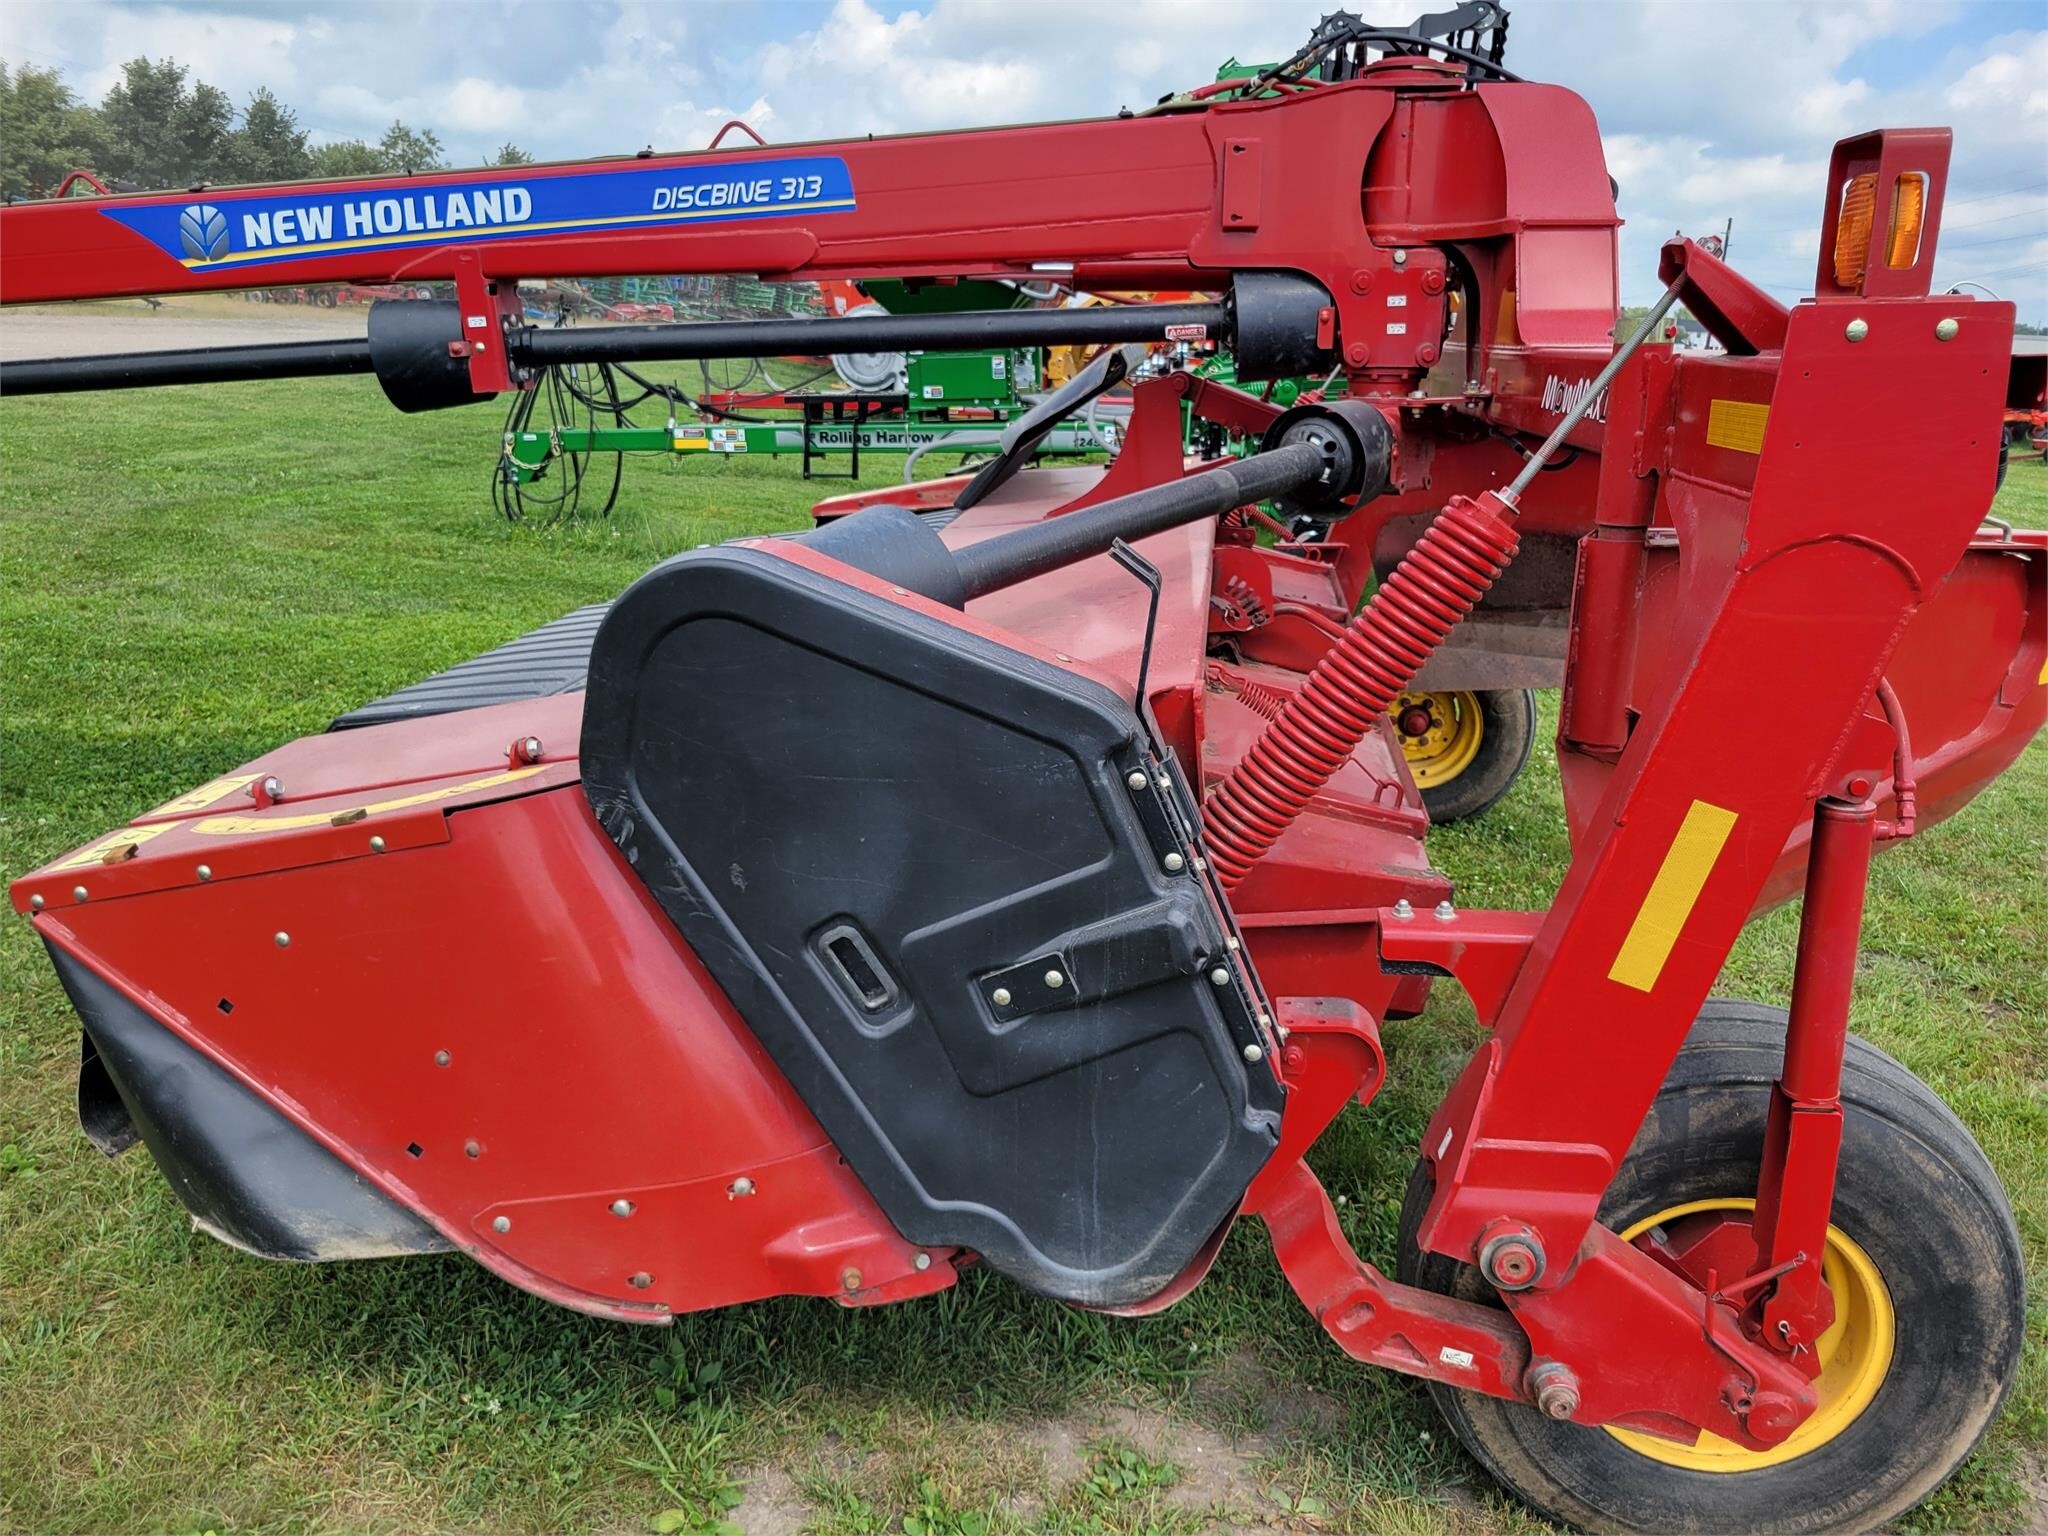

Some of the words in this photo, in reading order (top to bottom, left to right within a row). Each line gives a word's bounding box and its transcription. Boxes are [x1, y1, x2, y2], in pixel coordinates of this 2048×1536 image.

[652, 179, 772, 210] DISCBINE
[778, 176, 823, 200] 313
[243, 205, 333, 248] NEW
[343, 187, 532, 237] HOLLAND
